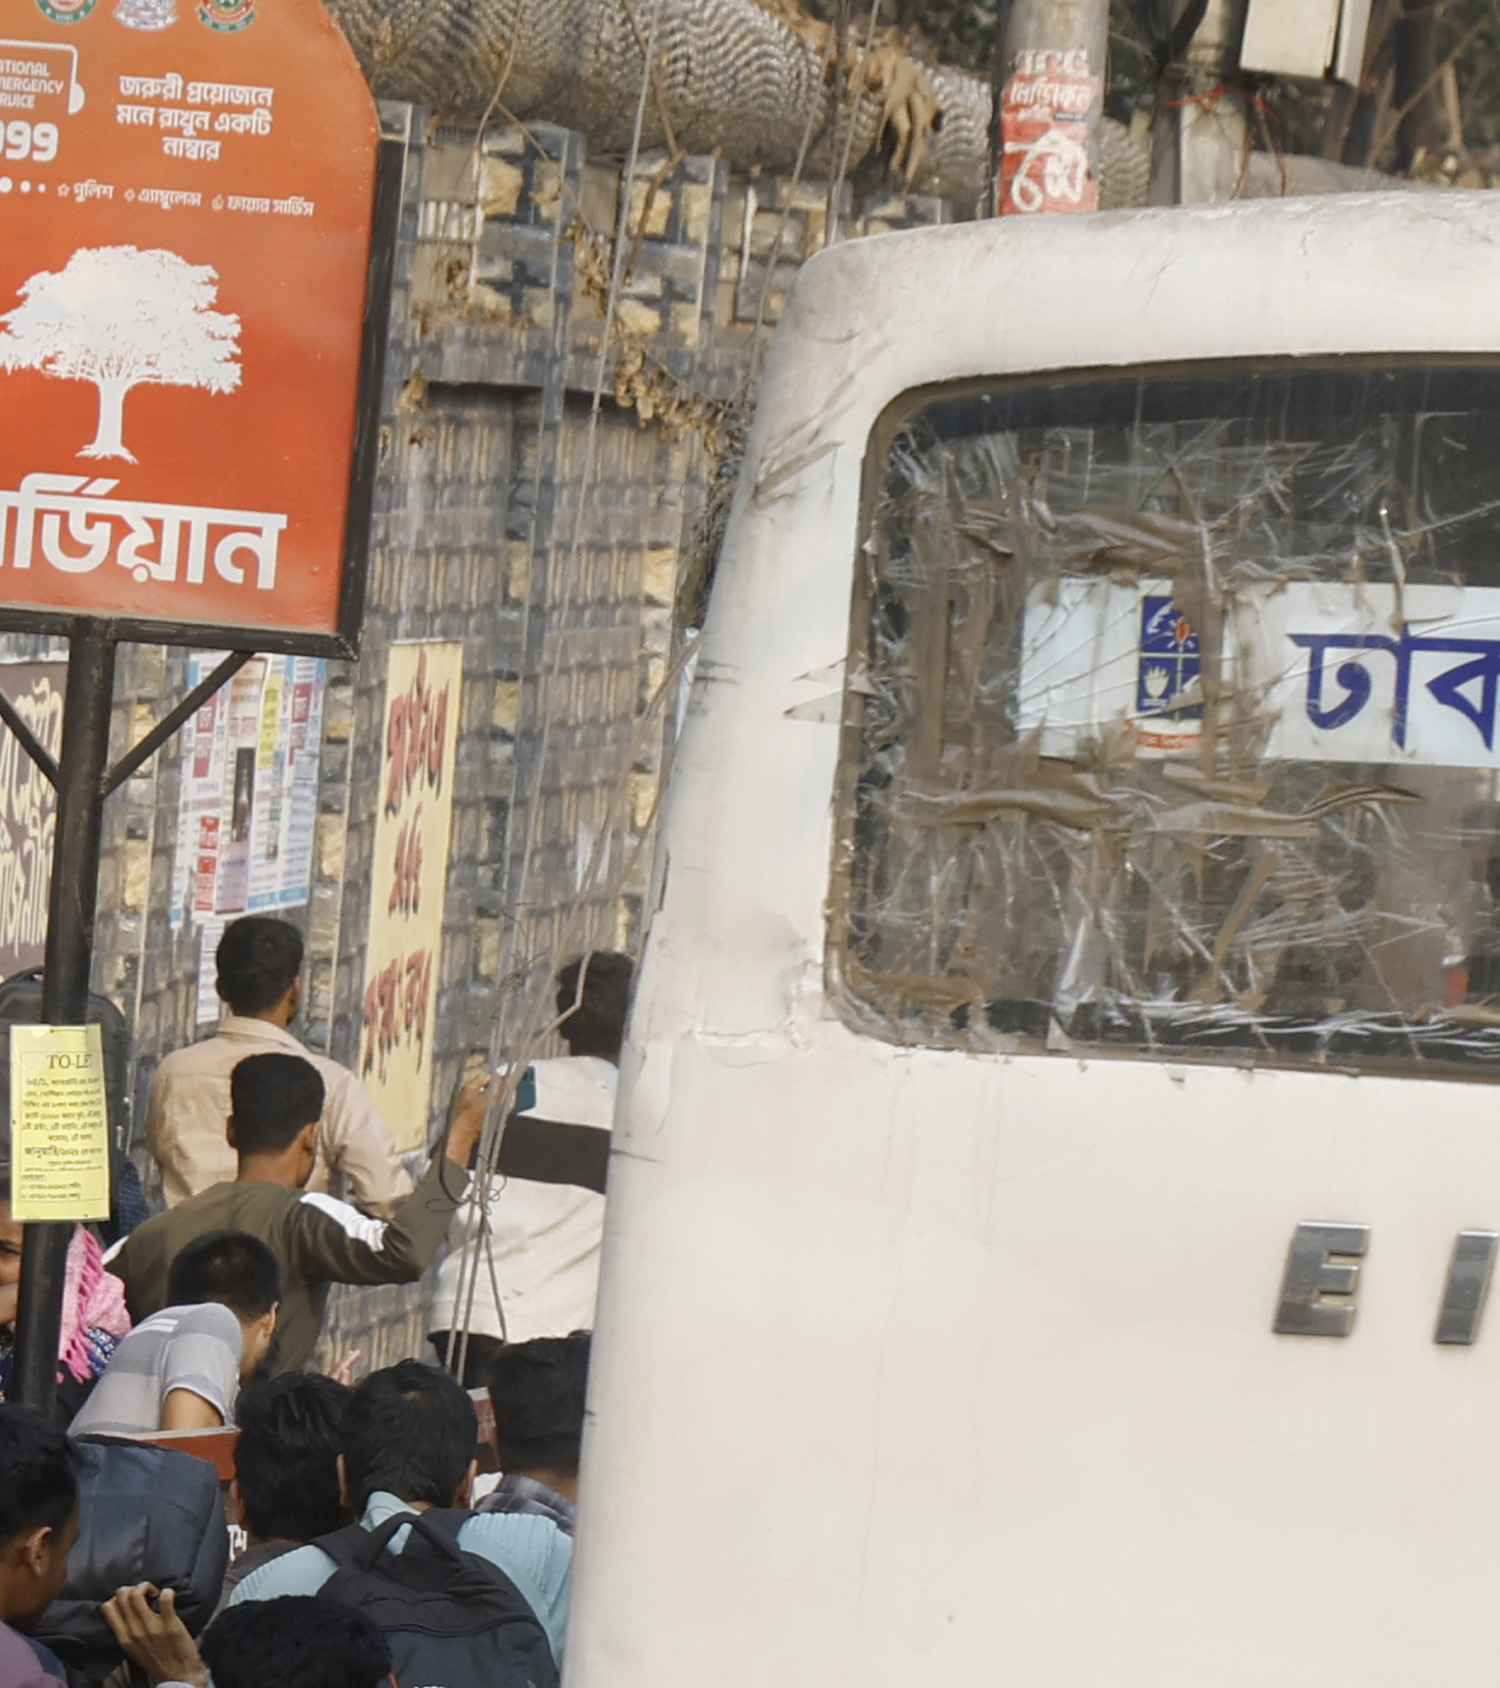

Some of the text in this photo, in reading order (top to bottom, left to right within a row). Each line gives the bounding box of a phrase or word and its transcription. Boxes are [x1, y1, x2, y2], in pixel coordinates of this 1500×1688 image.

[119, 72, 274, 107] জরুরী প্রয়োজনে
[116, 104, 272, 136] মনে রাখুন একটি
[162, 135, 221, 161] নাম্বার
[73, 179, 114, 203] পুলিশ
